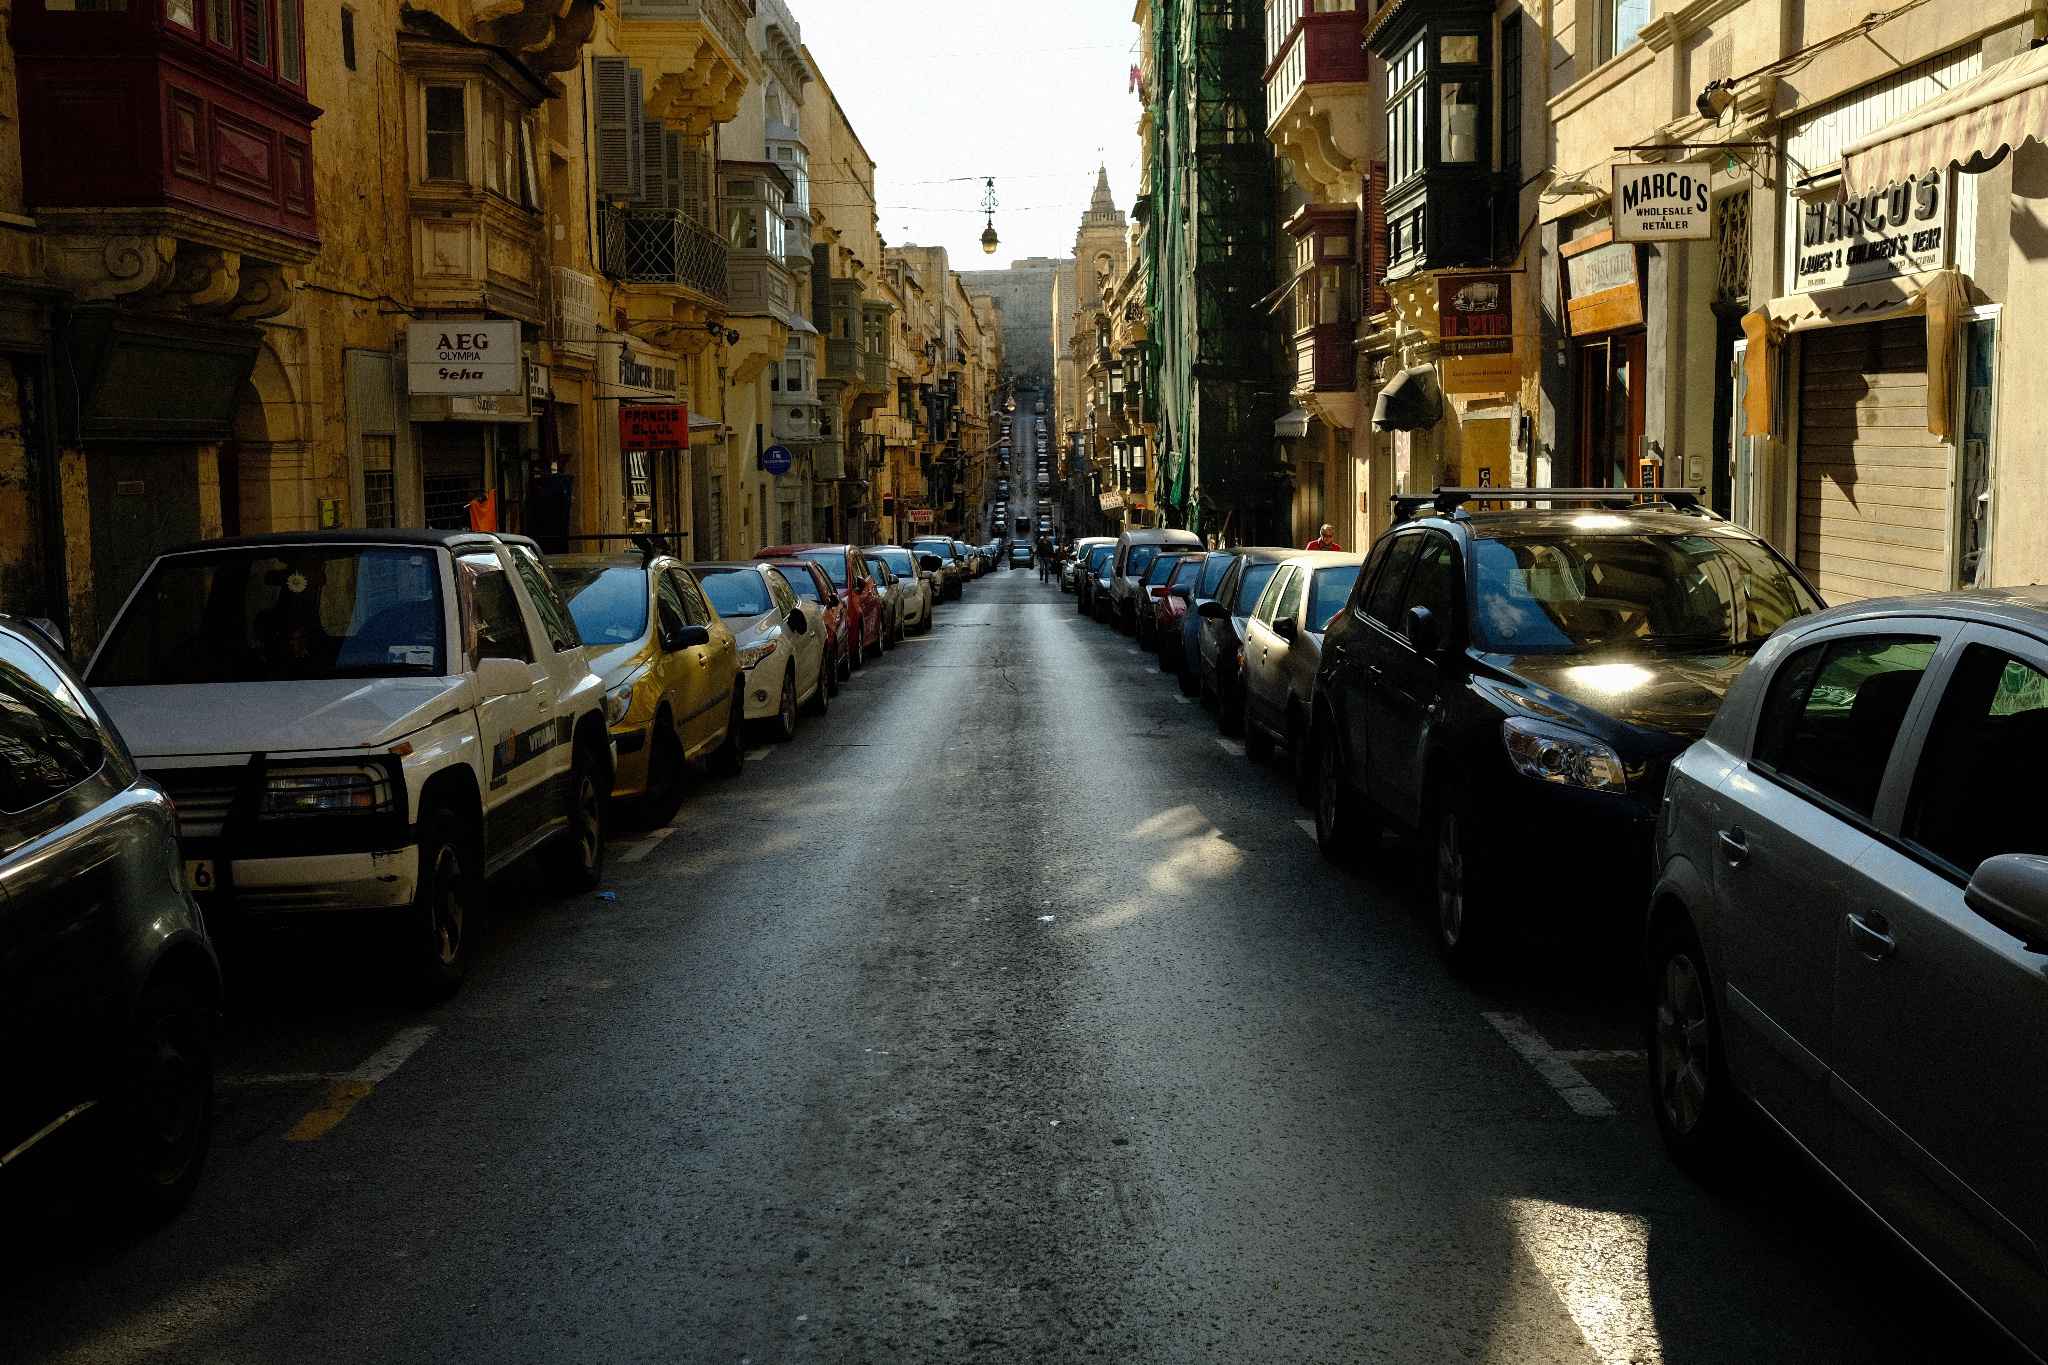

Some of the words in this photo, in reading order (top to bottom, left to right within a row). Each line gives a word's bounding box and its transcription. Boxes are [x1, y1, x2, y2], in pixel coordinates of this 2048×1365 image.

[1623, 172, 1708, 215] MARCO'S
[1636, 207, 1693, 217] WHOLESALE
[1642, 221, 1694, 231] RETAILER
[1911, 226, 1942, 253] WEAR
[436, 333, 489, 351] AEG
[439, 351, 481, 361] OLYMPIA
[438, 367, 485, 381] Geha
[624, 409, 680, 422] FRANCIS
